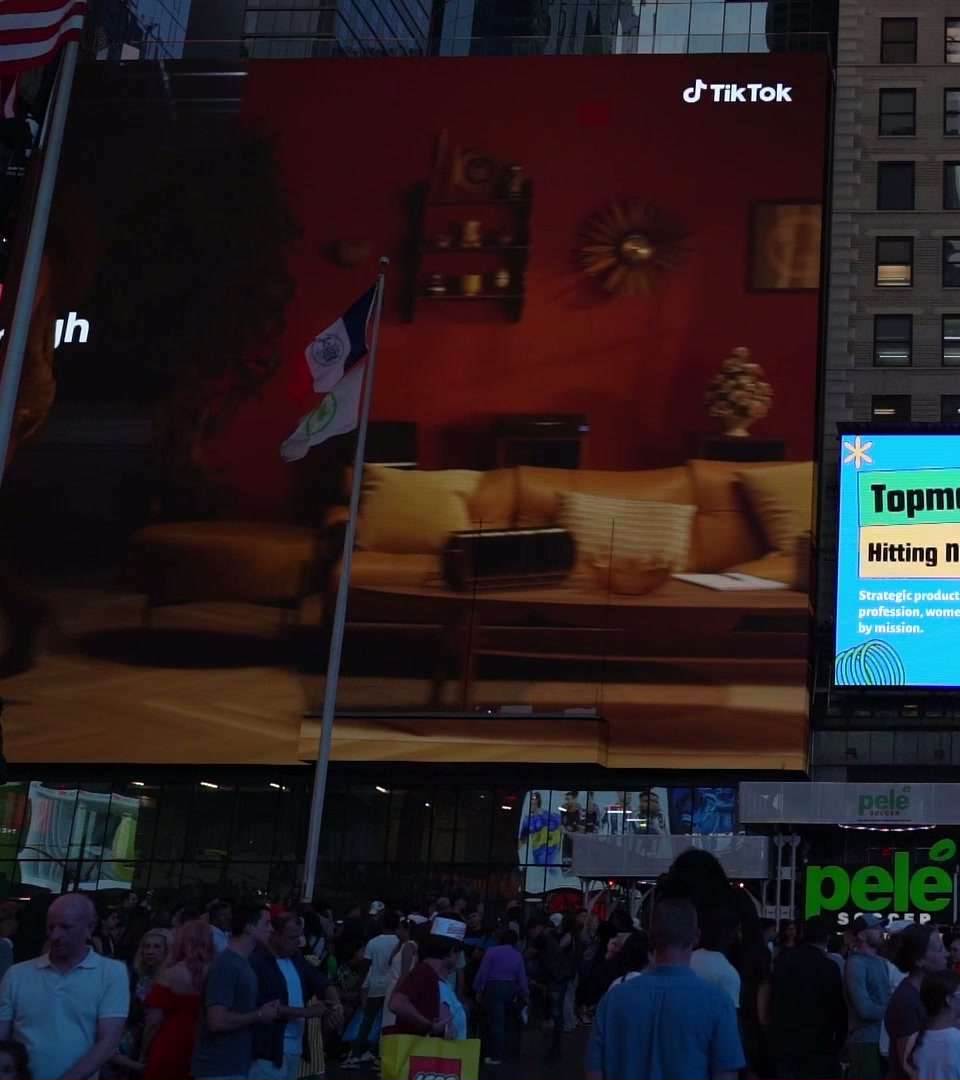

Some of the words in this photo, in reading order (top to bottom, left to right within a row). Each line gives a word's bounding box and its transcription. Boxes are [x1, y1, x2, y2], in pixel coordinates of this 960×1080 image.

[710, 83, 793, 103] TikTok
[867, 542, 938, 567] Hitting
[858, 589, 912, 603] Strategic
[914, 590, 960, 603] product
[858, 605, 924, 619] profession,
[858, 621, 872, 636] by
[875, 621, 925, 634] mission.
[858, 785, 911, 816] pelé
[805, 837, 958, 923] pelé
